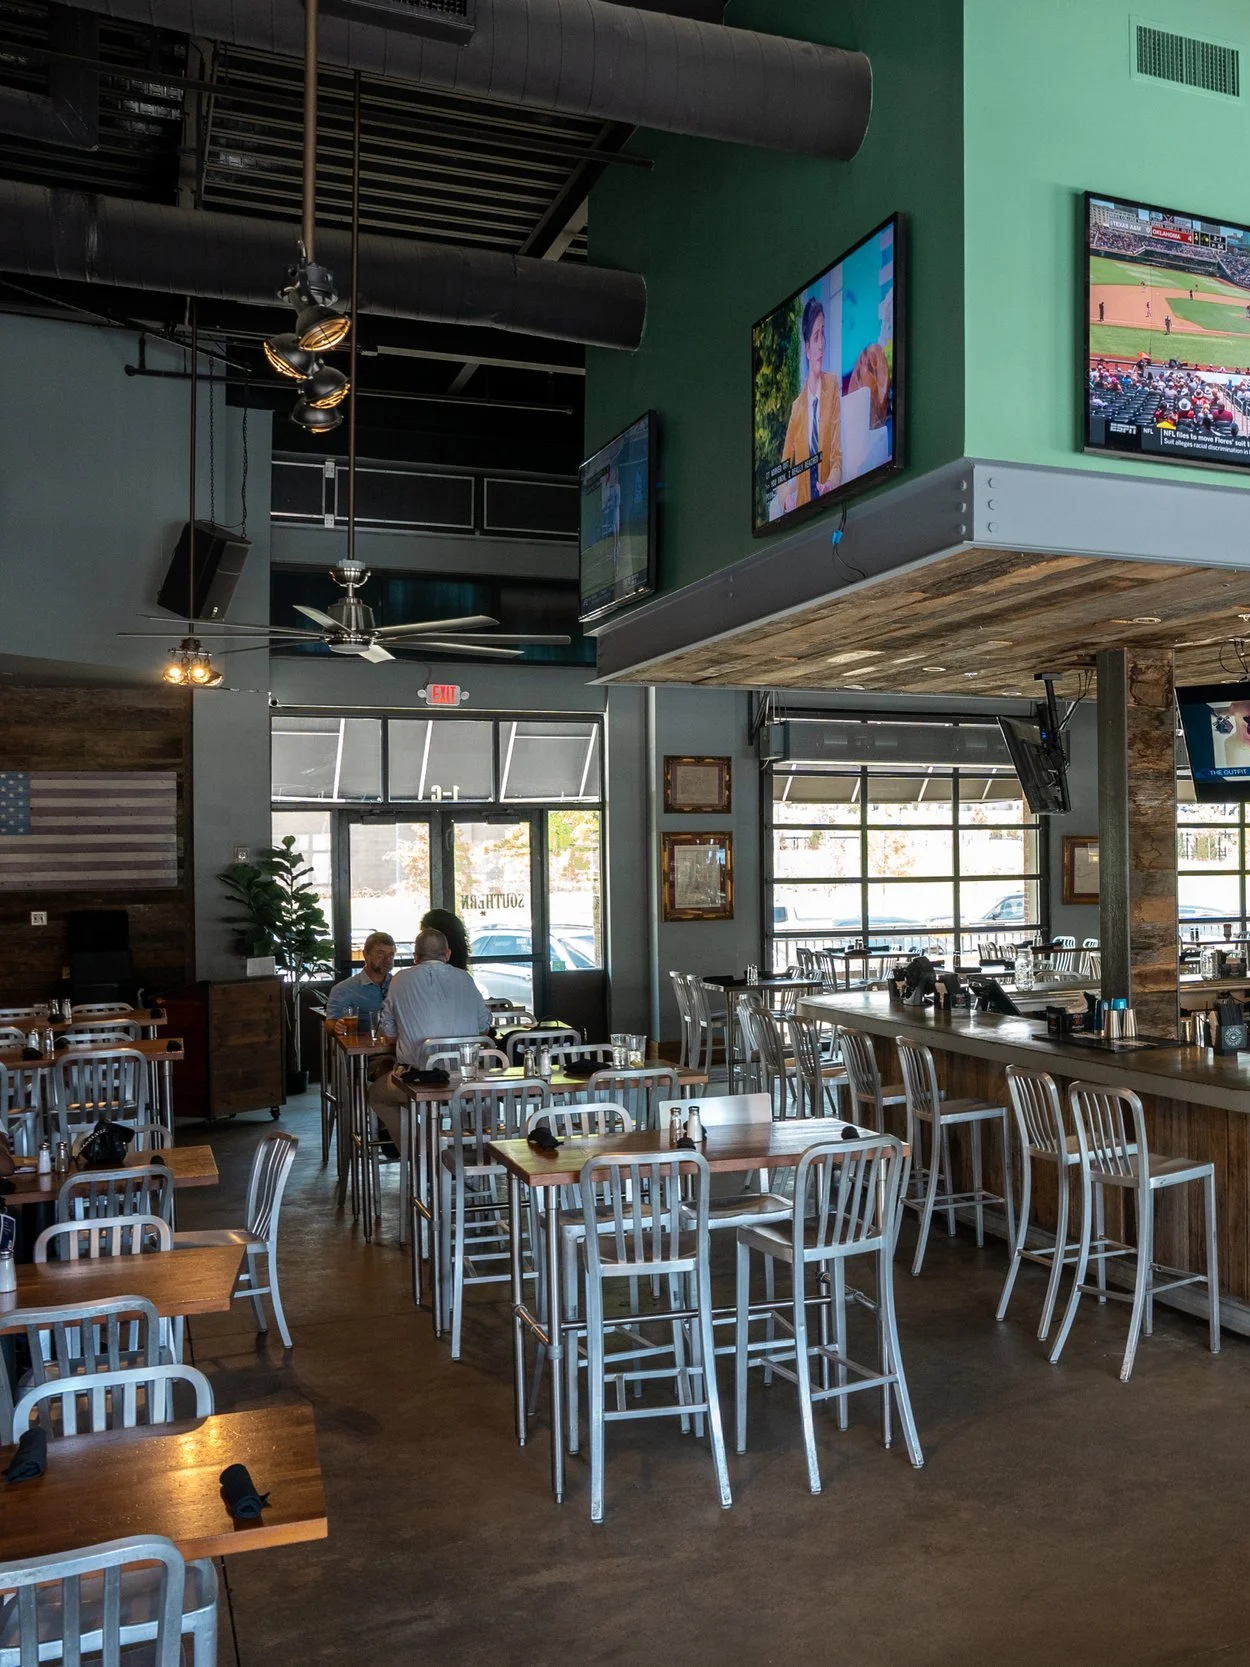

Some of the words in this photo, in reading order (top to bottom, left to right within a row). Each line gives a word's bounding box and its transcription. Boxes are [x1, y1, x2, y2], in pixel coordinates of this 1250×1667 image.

[1152, 229, 1181, 240] OKLAHOMA
[1110, 422, 1137, 435] ESPN
[1164, 430, 1176, 438] NFL
[1214, 436, 1234, 446] Flores'
[1176, 439, 1193, 448] alleges
[1194, 441, 1208, 450] racial
[1208, 442, 1243, 454] discrimination
[432, 685, 456, 704] EXIT
